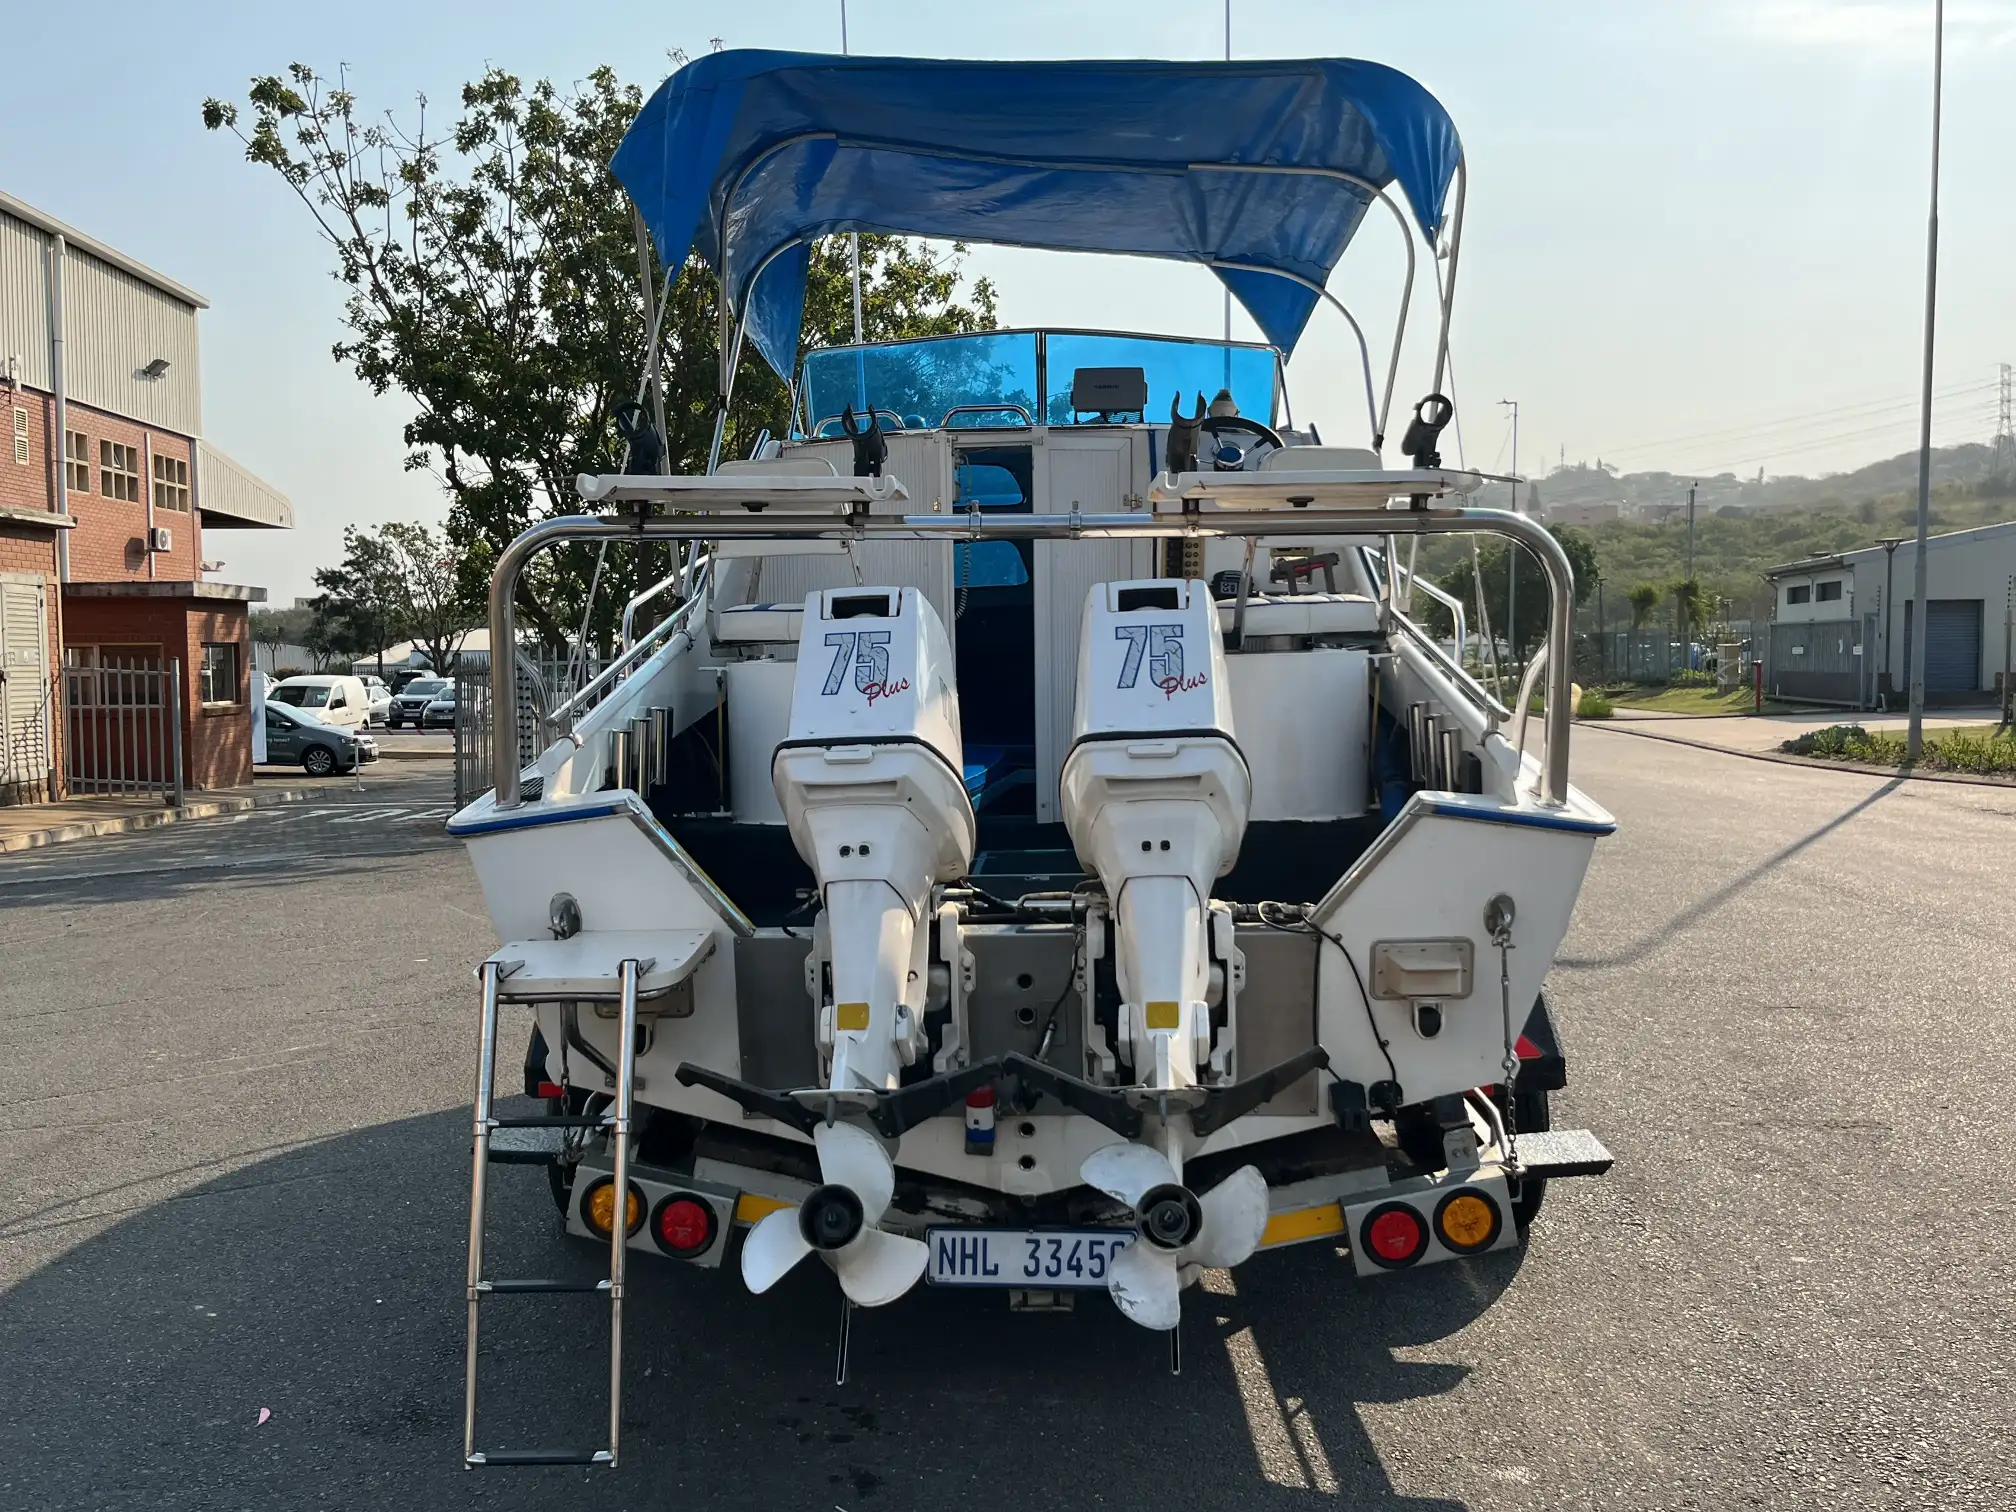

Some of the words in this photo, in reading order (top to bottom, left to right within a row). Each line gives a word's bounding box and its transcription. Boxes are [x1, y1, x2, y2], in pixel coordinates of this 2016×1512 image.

[821, 631, 891, 695] 75
[1115, 624, 1183, 689] 75
[862, 677, 910, 707] Plus
[1159, 672, 1208, 701] Plus
[938, 1237, 999, 1276] NHL
